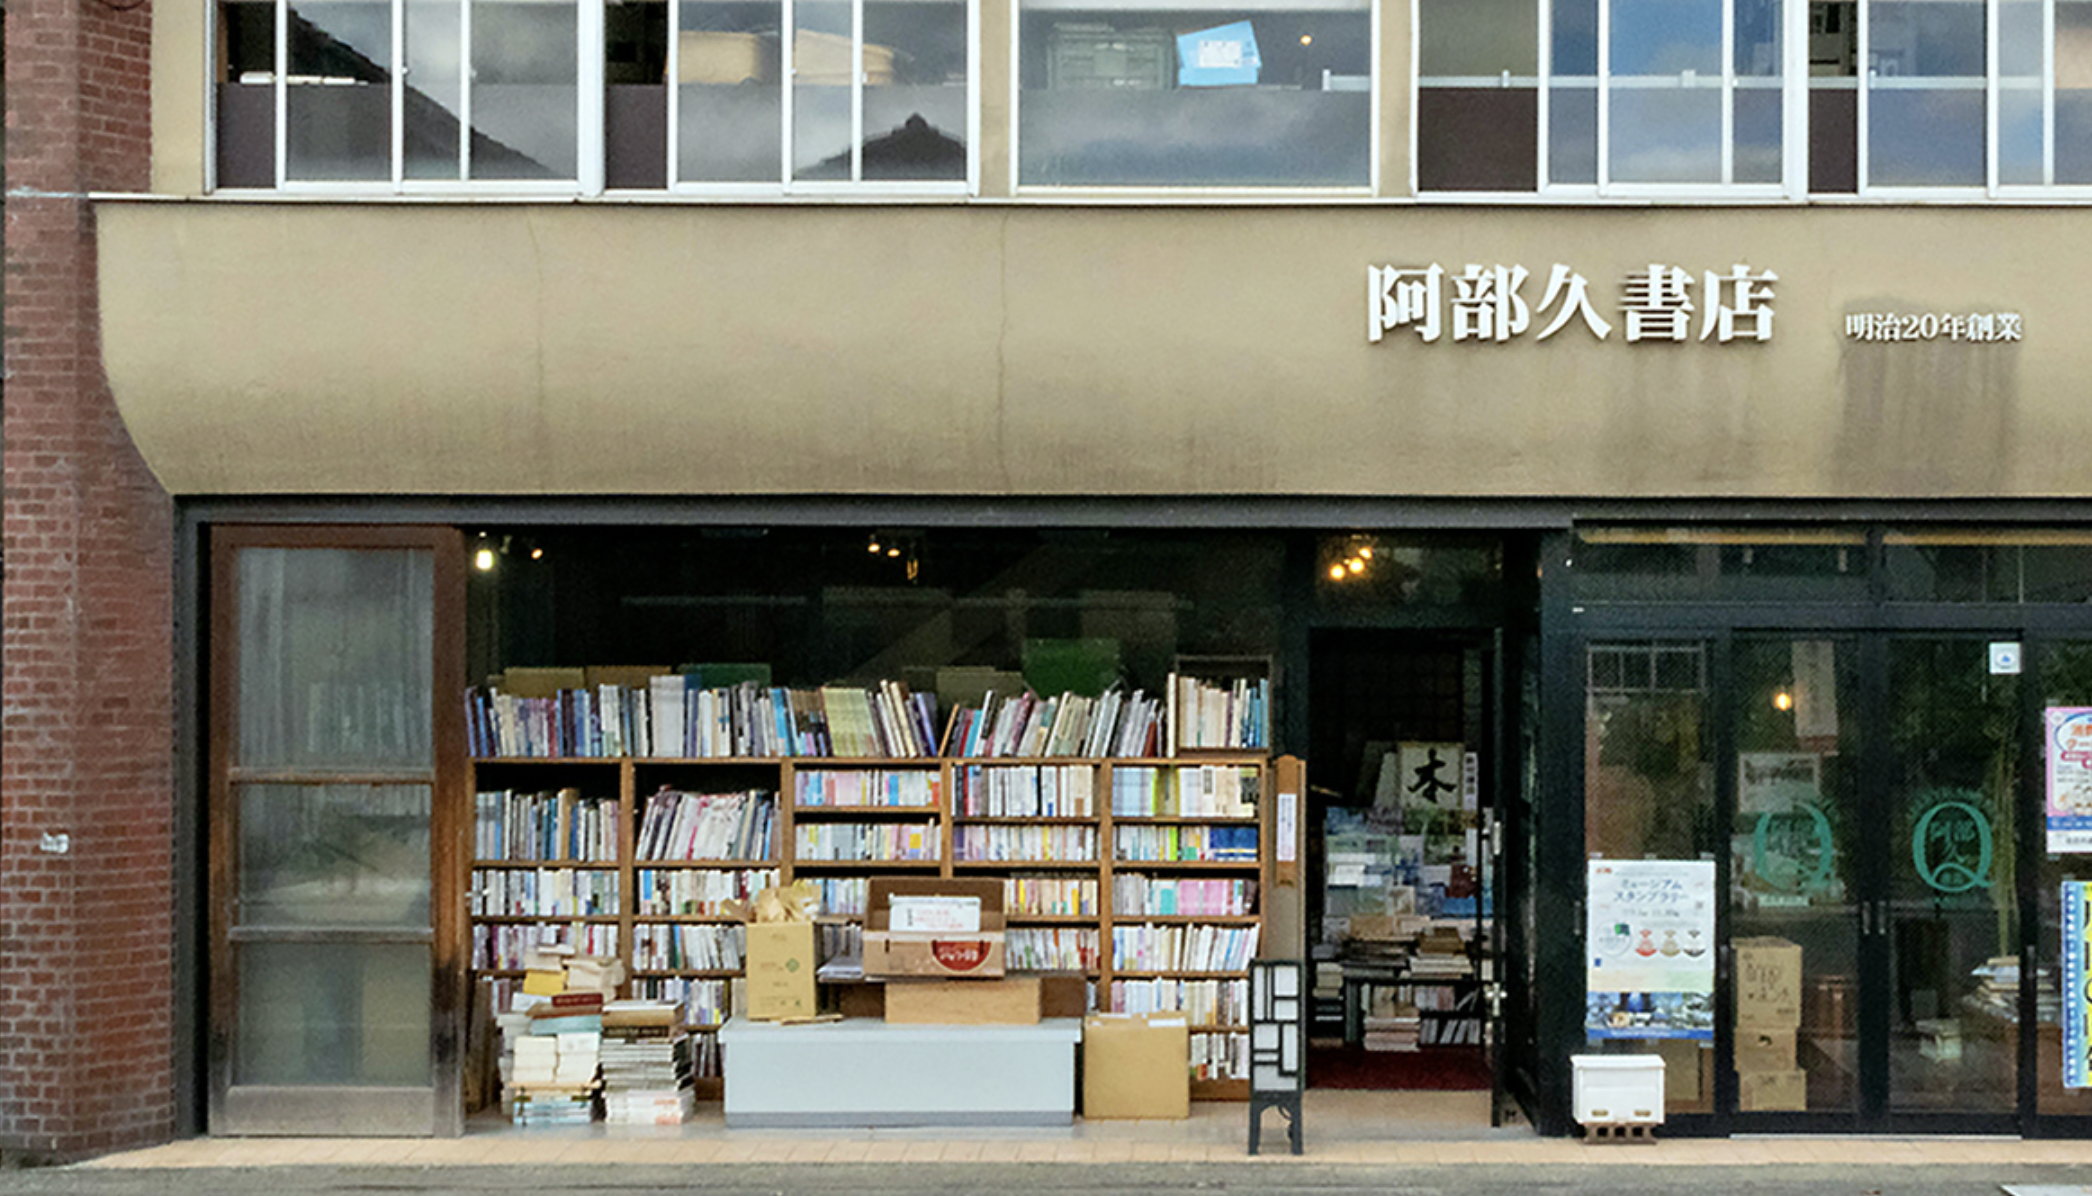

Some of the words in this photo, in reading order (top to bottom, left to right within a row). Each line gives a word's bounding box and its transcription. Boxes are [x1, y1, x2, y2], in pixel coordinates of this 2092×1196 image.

[1366, 263, 1779, 343] 阿部久書店
[1845, 312, 2023, 342] 明治20年創業
[1621, 879, 1683, 889] ミュージアム
[1614, 890, 1689, 902] スタンプラリー
